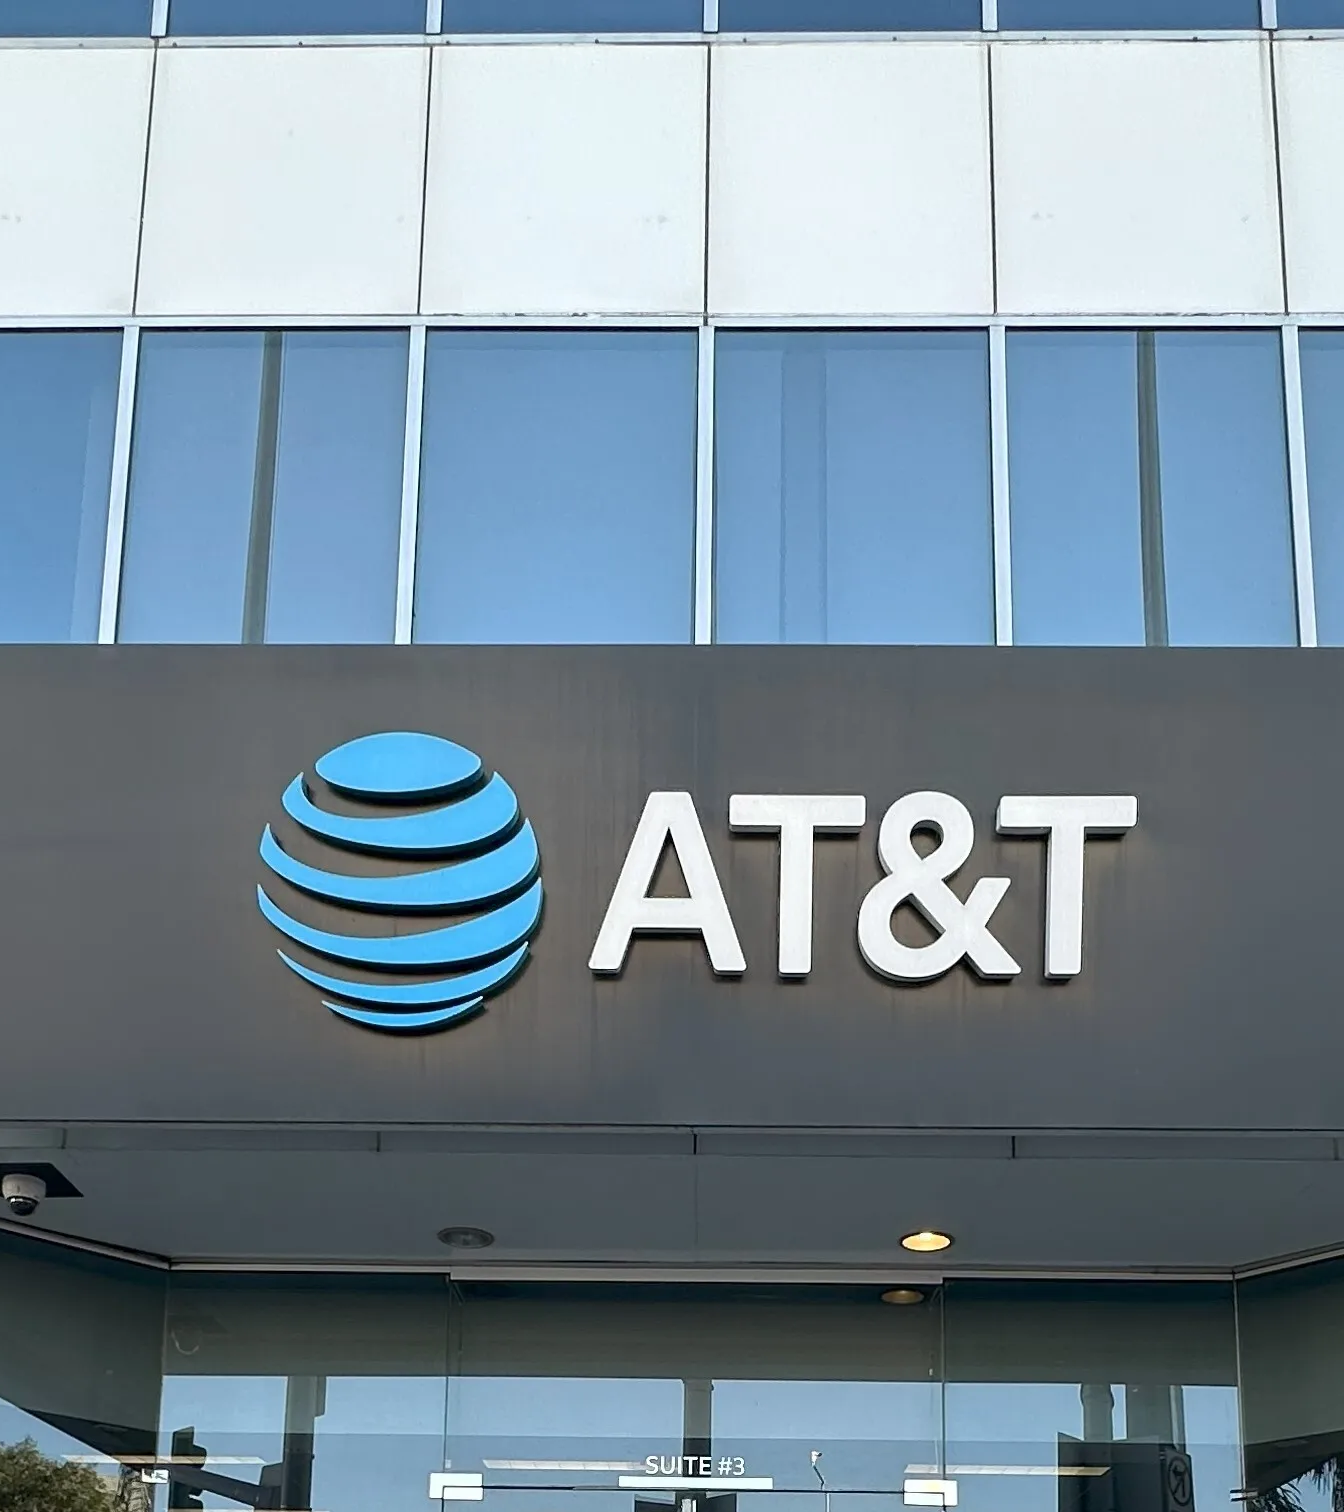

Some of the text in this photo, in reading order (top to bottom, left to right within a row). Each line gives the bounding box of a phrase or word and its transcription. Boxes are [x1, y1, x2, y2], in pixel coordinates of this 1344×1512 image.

[587, 790, 1140, 982] AT&T
[645, 1456, 746, 1476] SUITE #3
